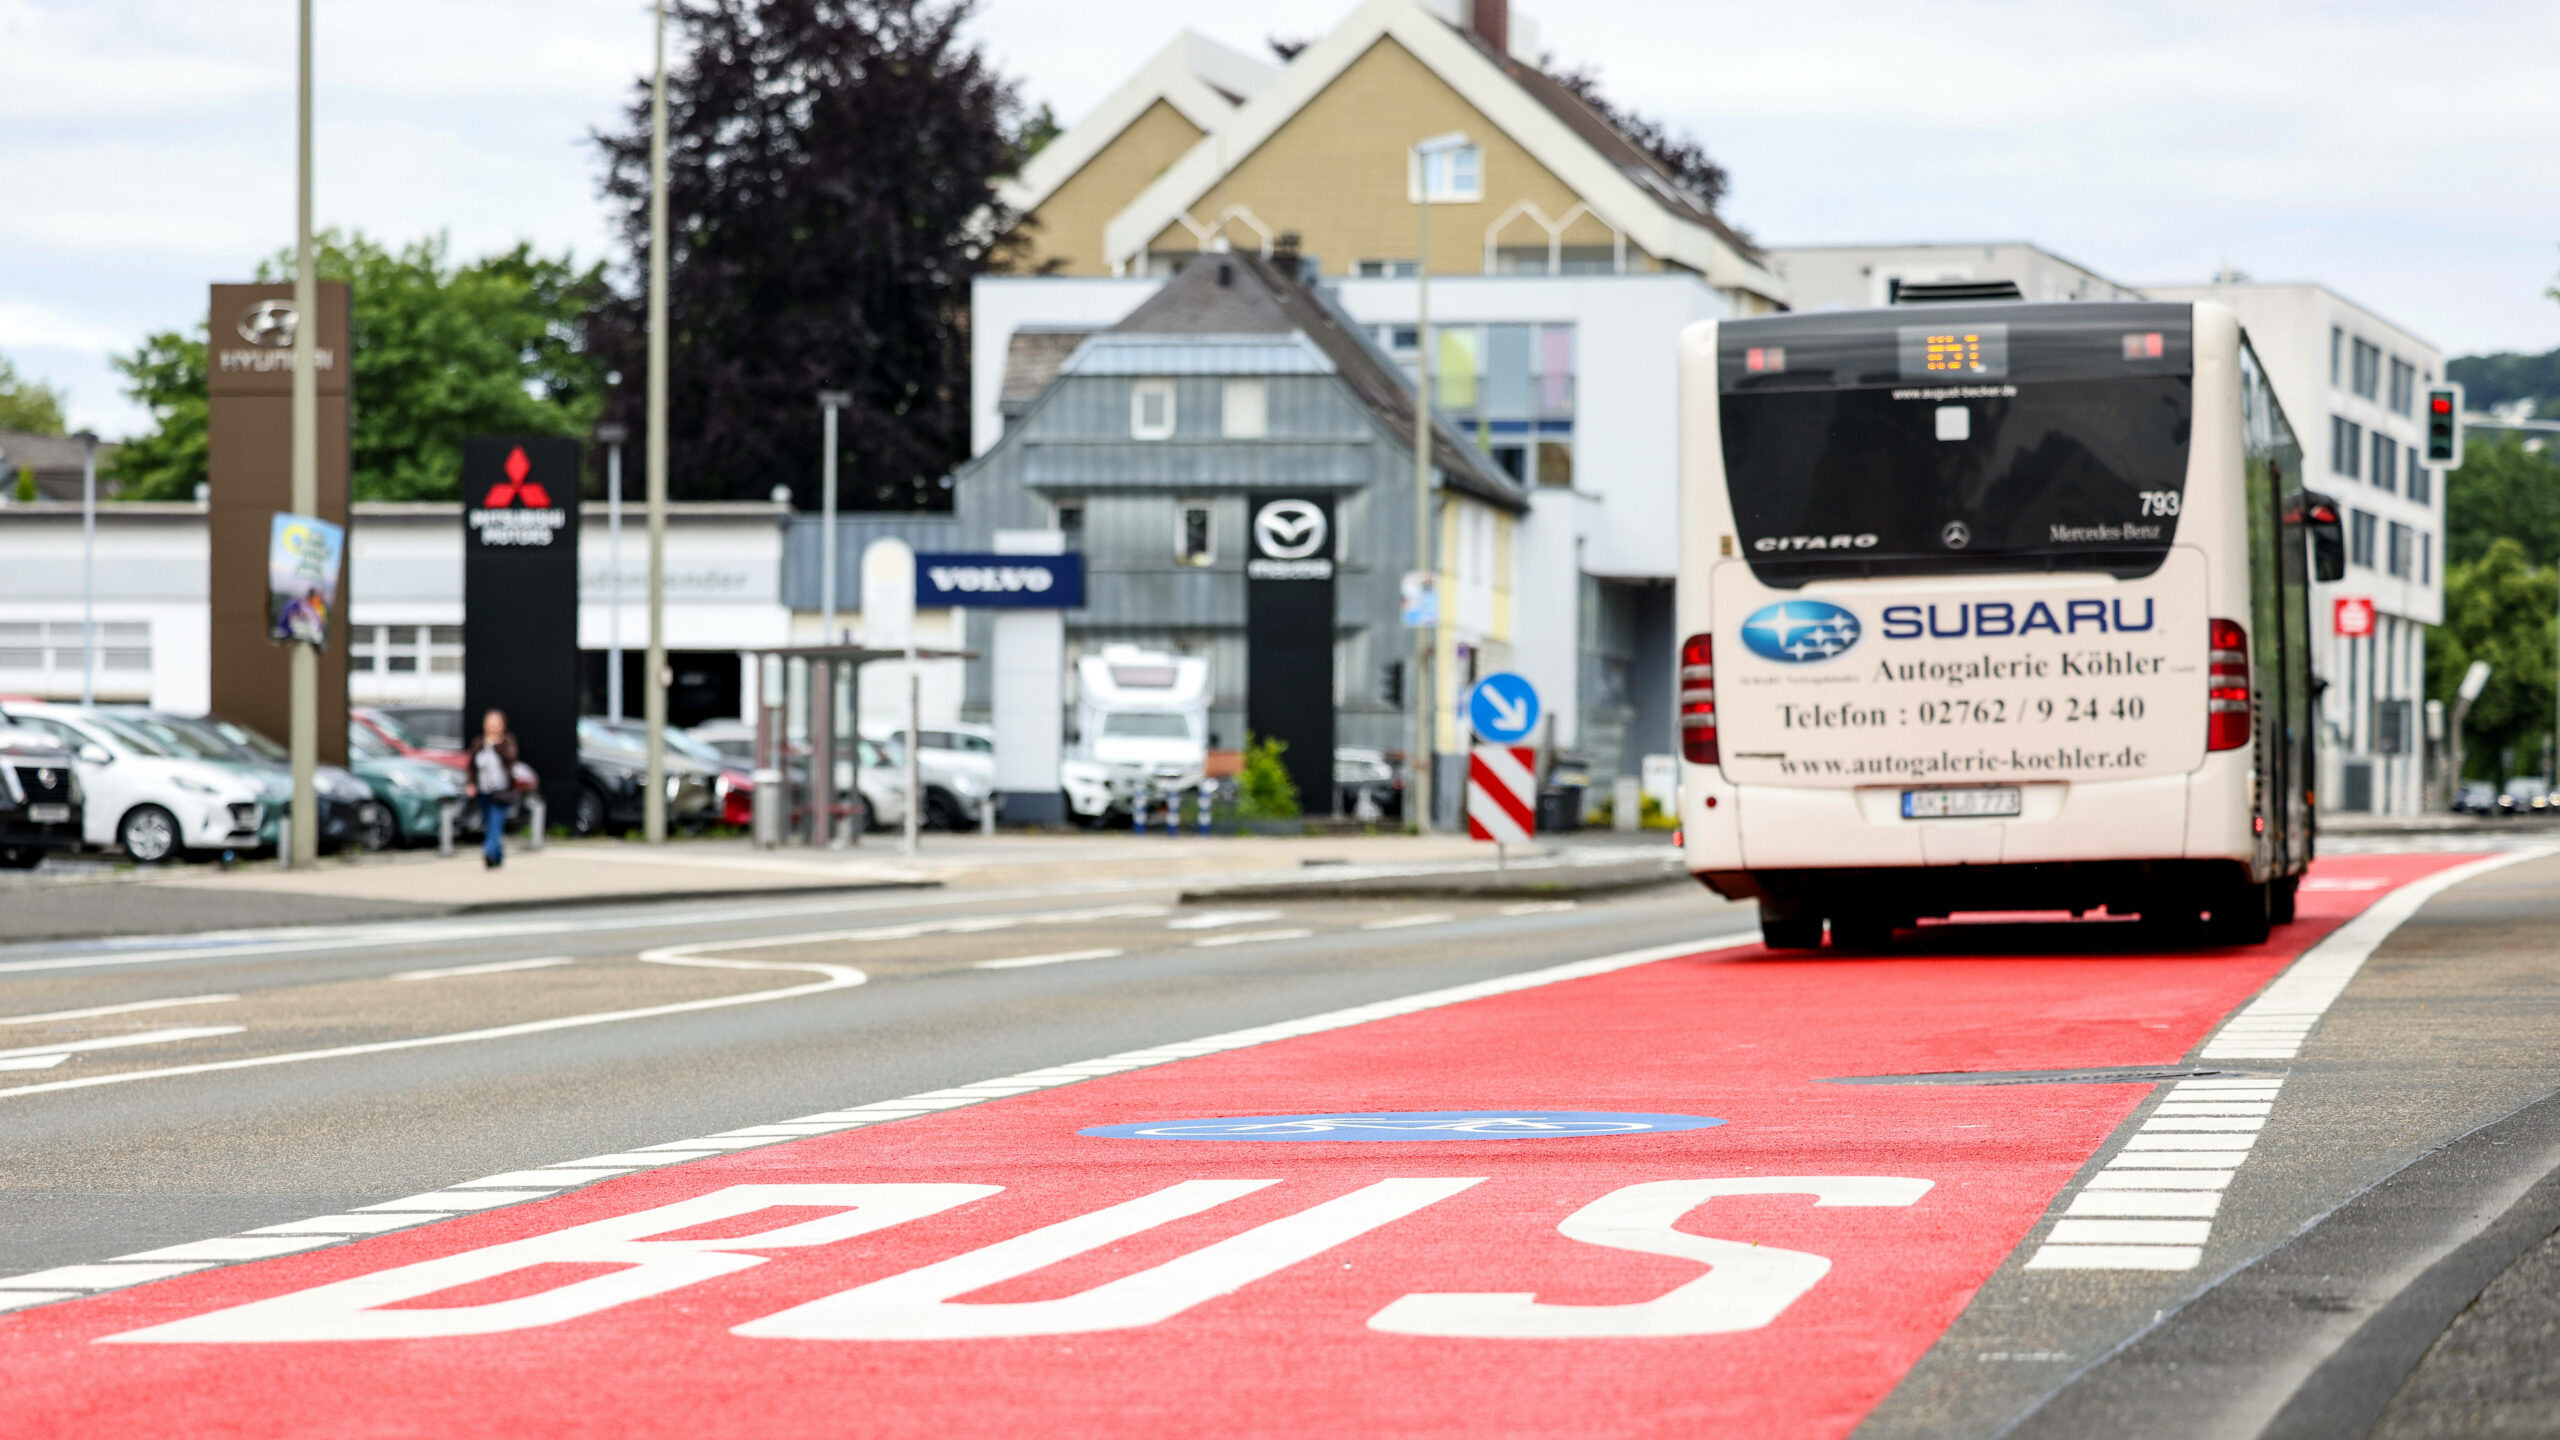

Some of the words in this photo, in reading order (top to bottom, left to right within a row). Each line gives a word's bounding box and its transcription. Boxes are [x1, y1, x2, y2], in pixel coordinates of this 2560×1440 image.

[2139, 490, 2180, 517] 793
[1754, 533, 1879, 552] CITARO
[2050, 523, 2160, 542] Mercedes-Benz
[928, 565, 1054, 592] VOLVO
[1882, 598, 2155, 640] SUBARU
[1873, 653, 2048, 686] Autogalerie
[2061, 650, 2165, 676] Köhler
[1777, 702, 1887, 729] Telefon
[1919, 699, 2006, 725] 02762
[2037, 698, 2053, 721] 9
[2065, 697, 2098, 722] 24
[2110, 696, 2145, 720] 40
[1780, 746, 2147, 776] www.autogalerie-koehler.de
[92, 1176, 1936, 1343] BUS
